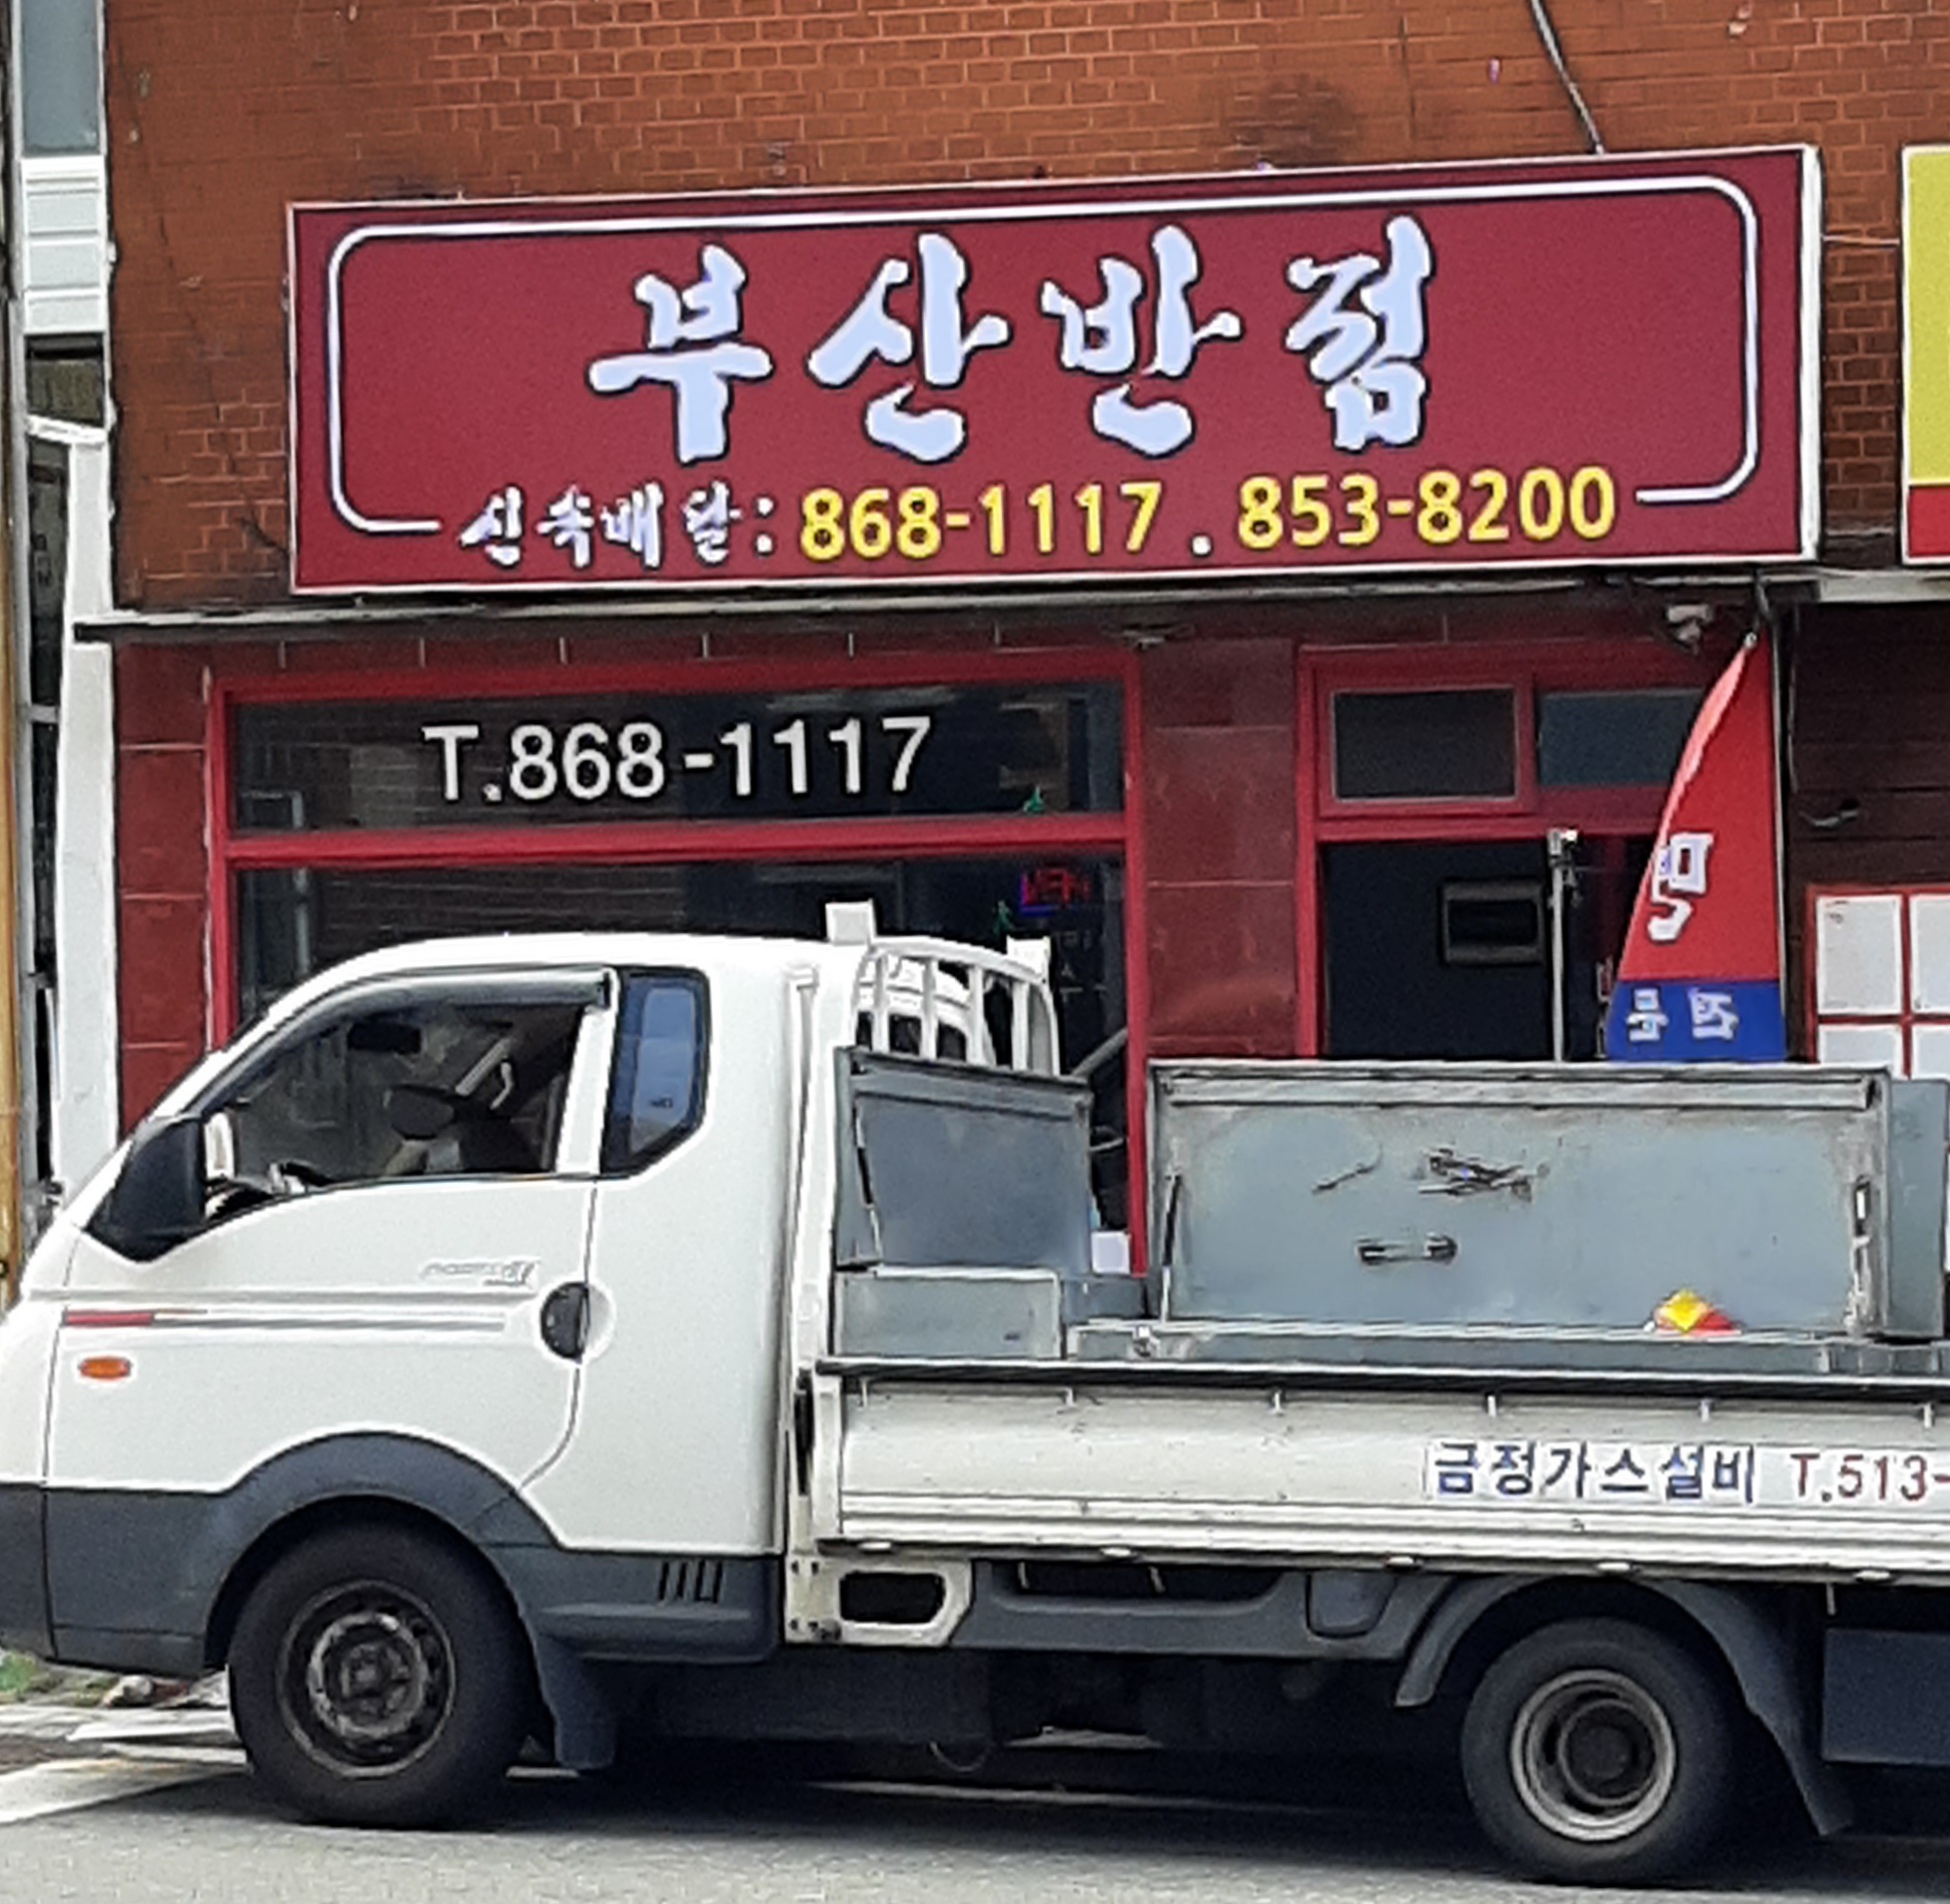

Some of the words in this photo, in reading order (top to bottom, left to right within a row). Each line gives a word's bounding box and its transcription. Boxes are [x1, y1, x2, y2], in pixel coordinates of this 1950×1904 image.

[588, 216, 1437, 464] 부산반점
[799, 483, 1162, 561] 868-1117
[1238, 466, 1615, 548] 853-8200
[1435, 1441, 1755, 1503] 금정가스설비
